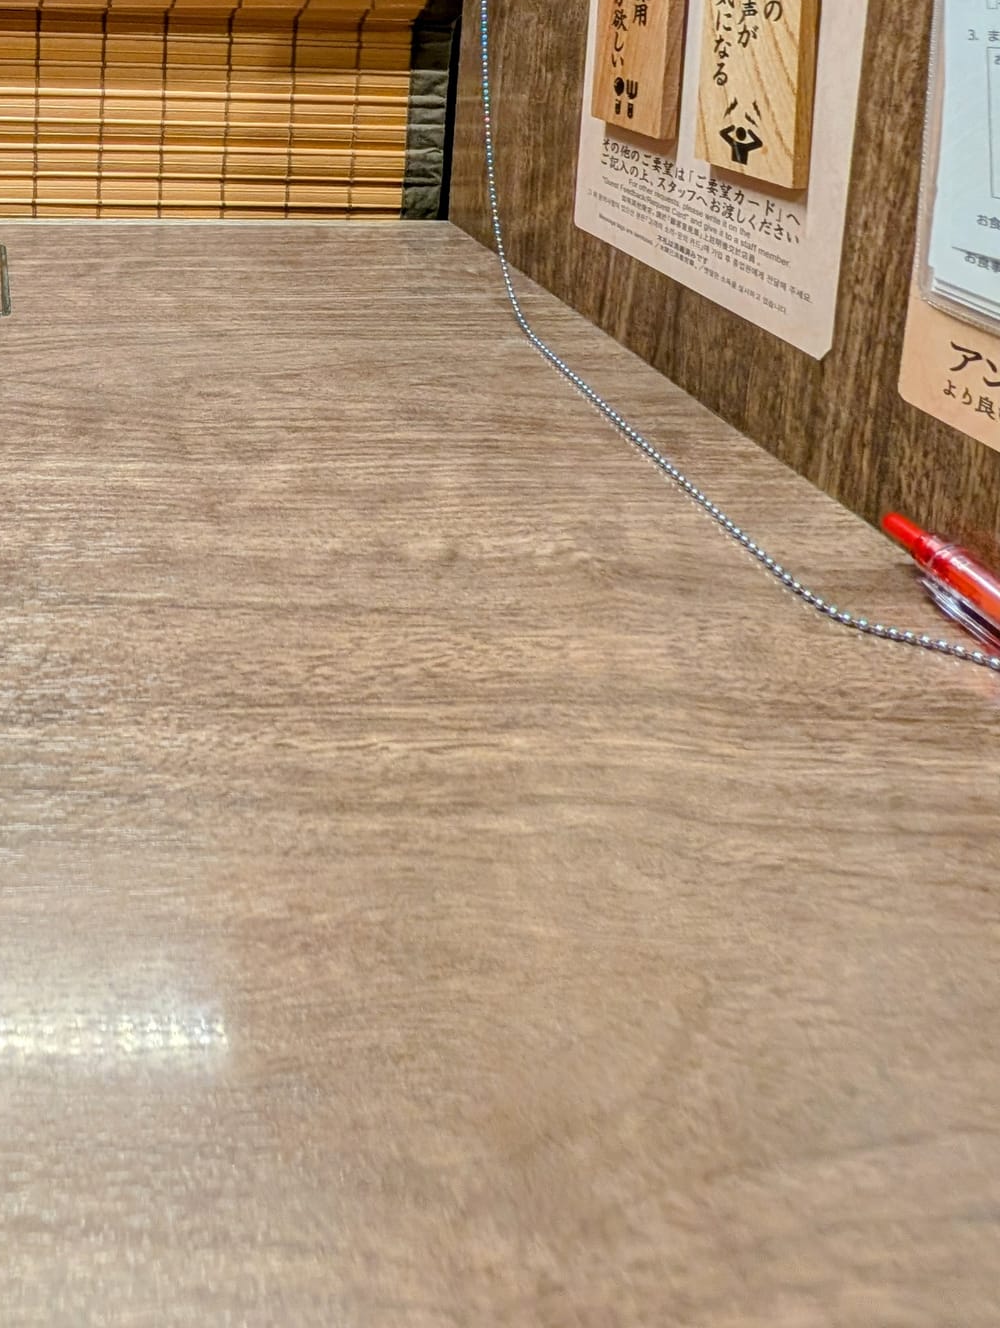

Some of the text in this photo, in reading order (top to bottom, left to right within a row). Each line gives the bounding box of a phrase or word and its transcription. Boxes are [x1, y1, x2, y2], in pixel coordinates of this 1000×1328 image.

[600, 153, 800, 245] ご記入の上、スタッフへお渡しください
